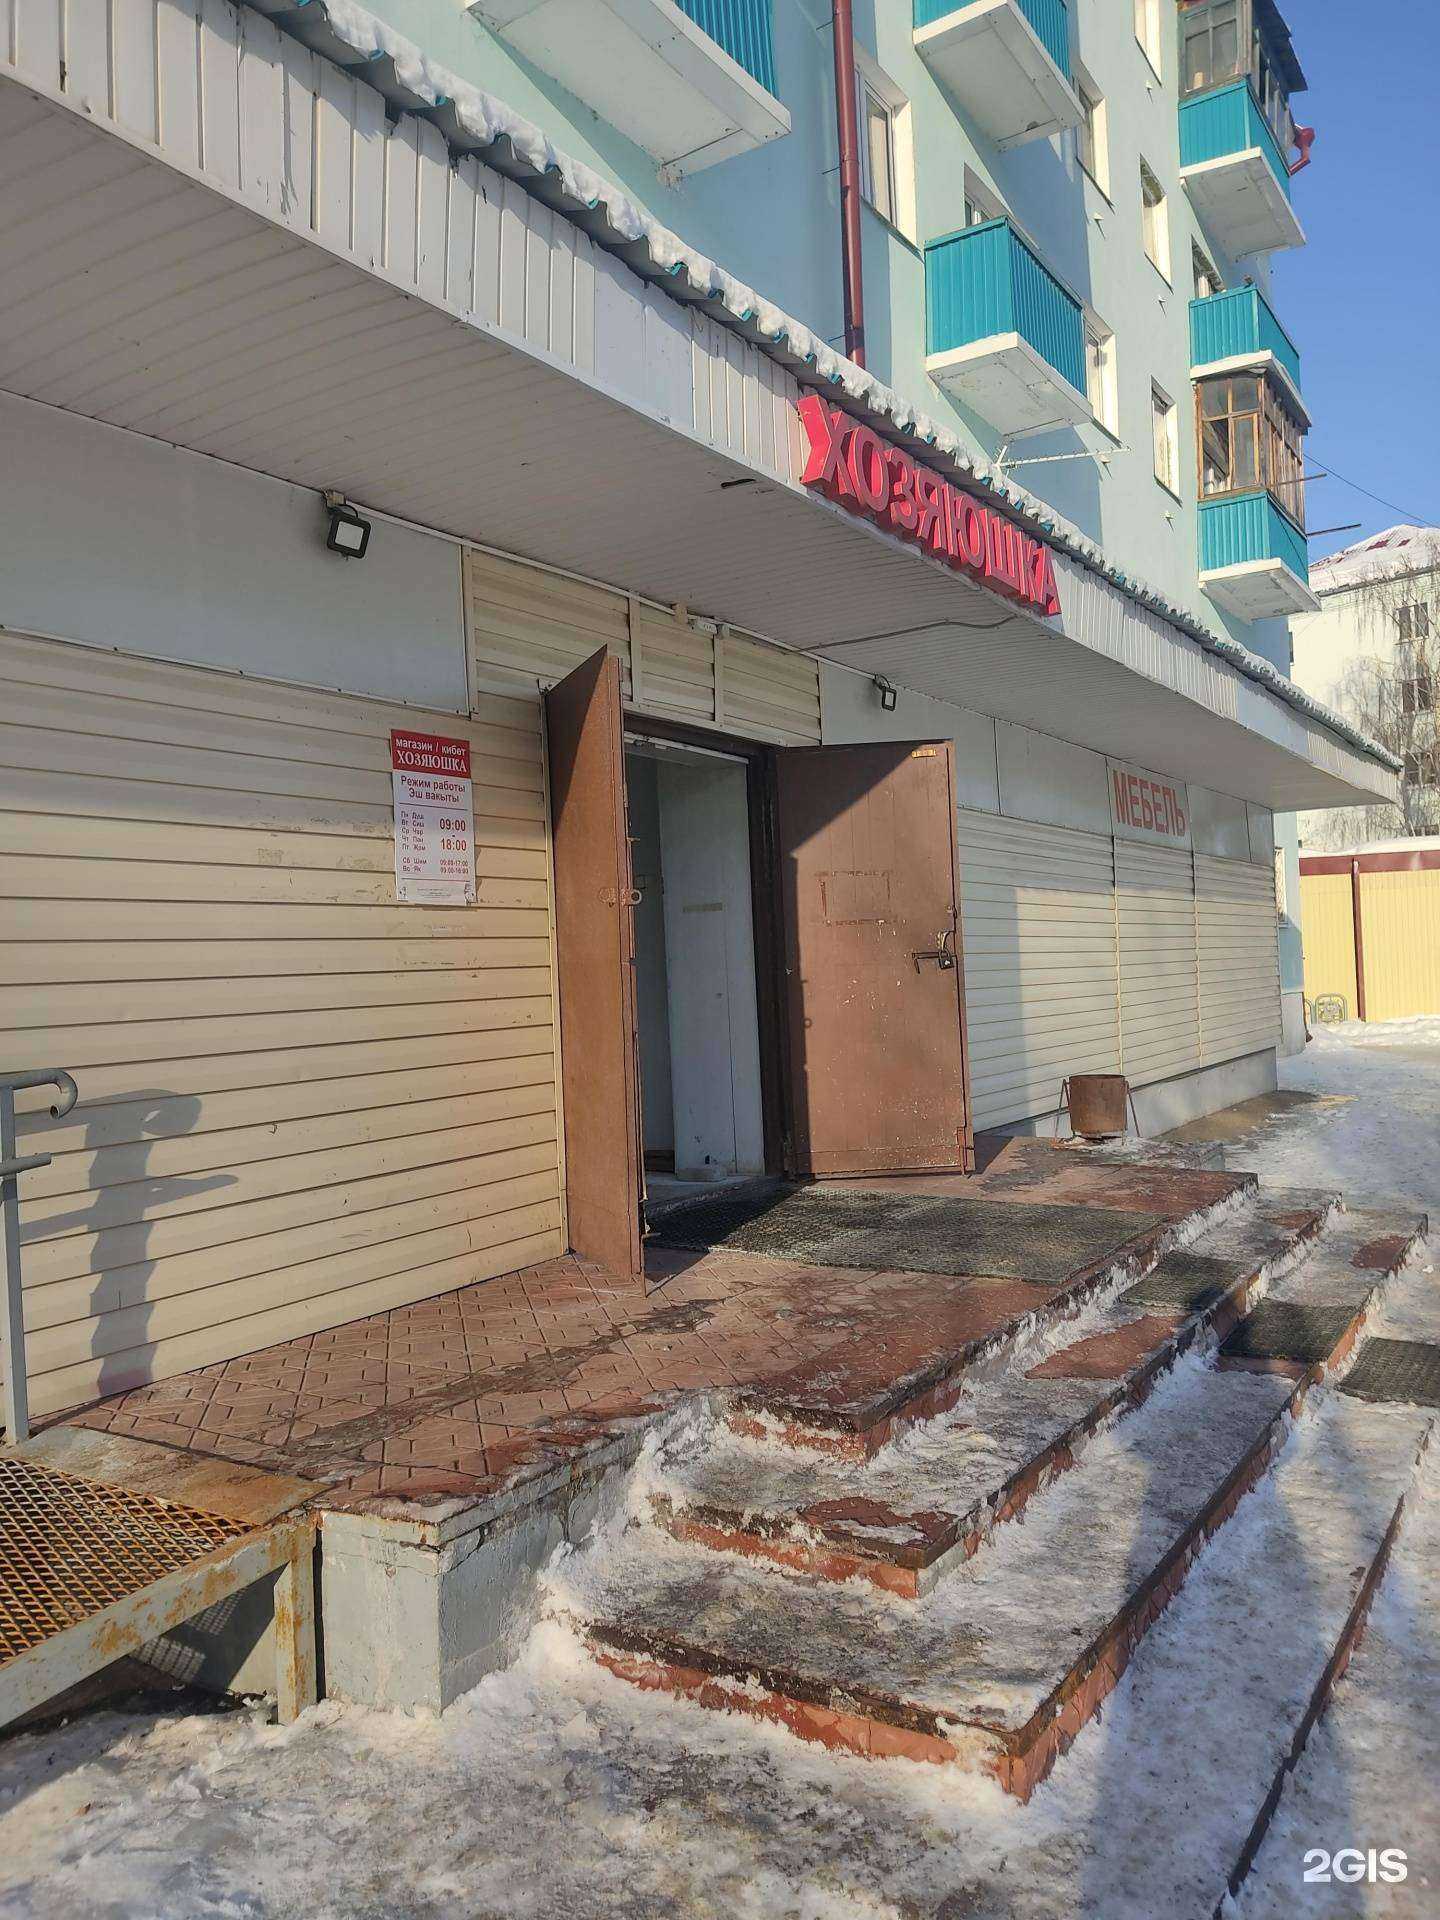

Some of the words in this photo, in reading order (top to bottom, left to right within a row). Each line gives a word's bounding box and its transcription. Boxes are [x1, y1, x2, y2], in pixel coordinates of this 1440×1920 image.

[797, 394, 1062, 616] ХОЗЯЮШКА
[396, 738, 433, 751] магазин
[397, 750, 467, 772] ХОЗЯЮШКА
[401, 775, 431, 788] Режим
[433, 780, 466, 793] работы
[408, 787, 423, 799] Эш
[425, 792, 460, 803] вакыты
[1112, 769, 1186, 837] МЕБЕЛЬ
[402, 827, 410, 835] Ср
[439, 818, 466, 832] 09:00
[441, 837, 467, 851] 18:00
[402, 856, 411, 864] Сб
